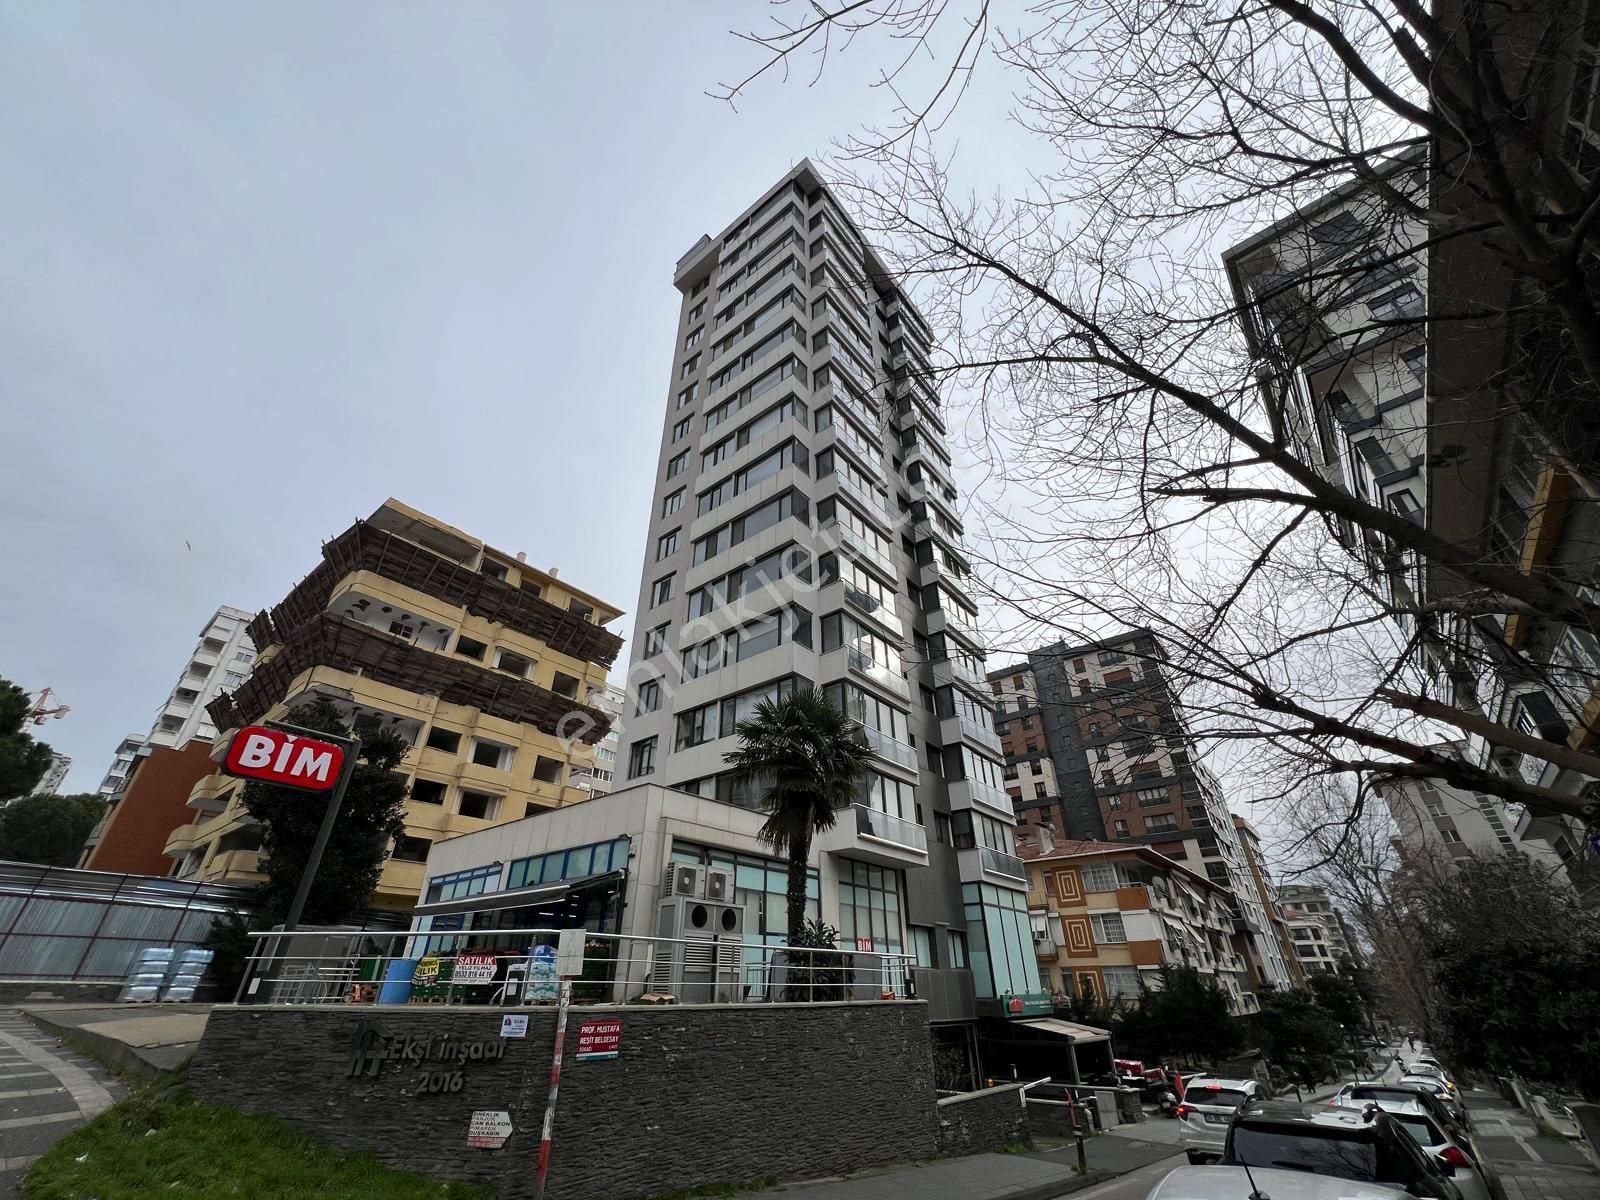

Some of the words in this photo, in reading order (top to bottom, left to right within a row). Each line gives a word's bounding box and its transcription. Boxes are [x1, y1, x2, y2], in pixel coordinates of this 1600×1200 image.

[238, 734, 333, 782] BİM
[458, 956, 494, 965] SATILIK
[596, 1025, 620, 1033] MUSTAFA
[594, 1035, 619, 1044] BELGESAY
[415, 1071, 464, 1092] 2016
